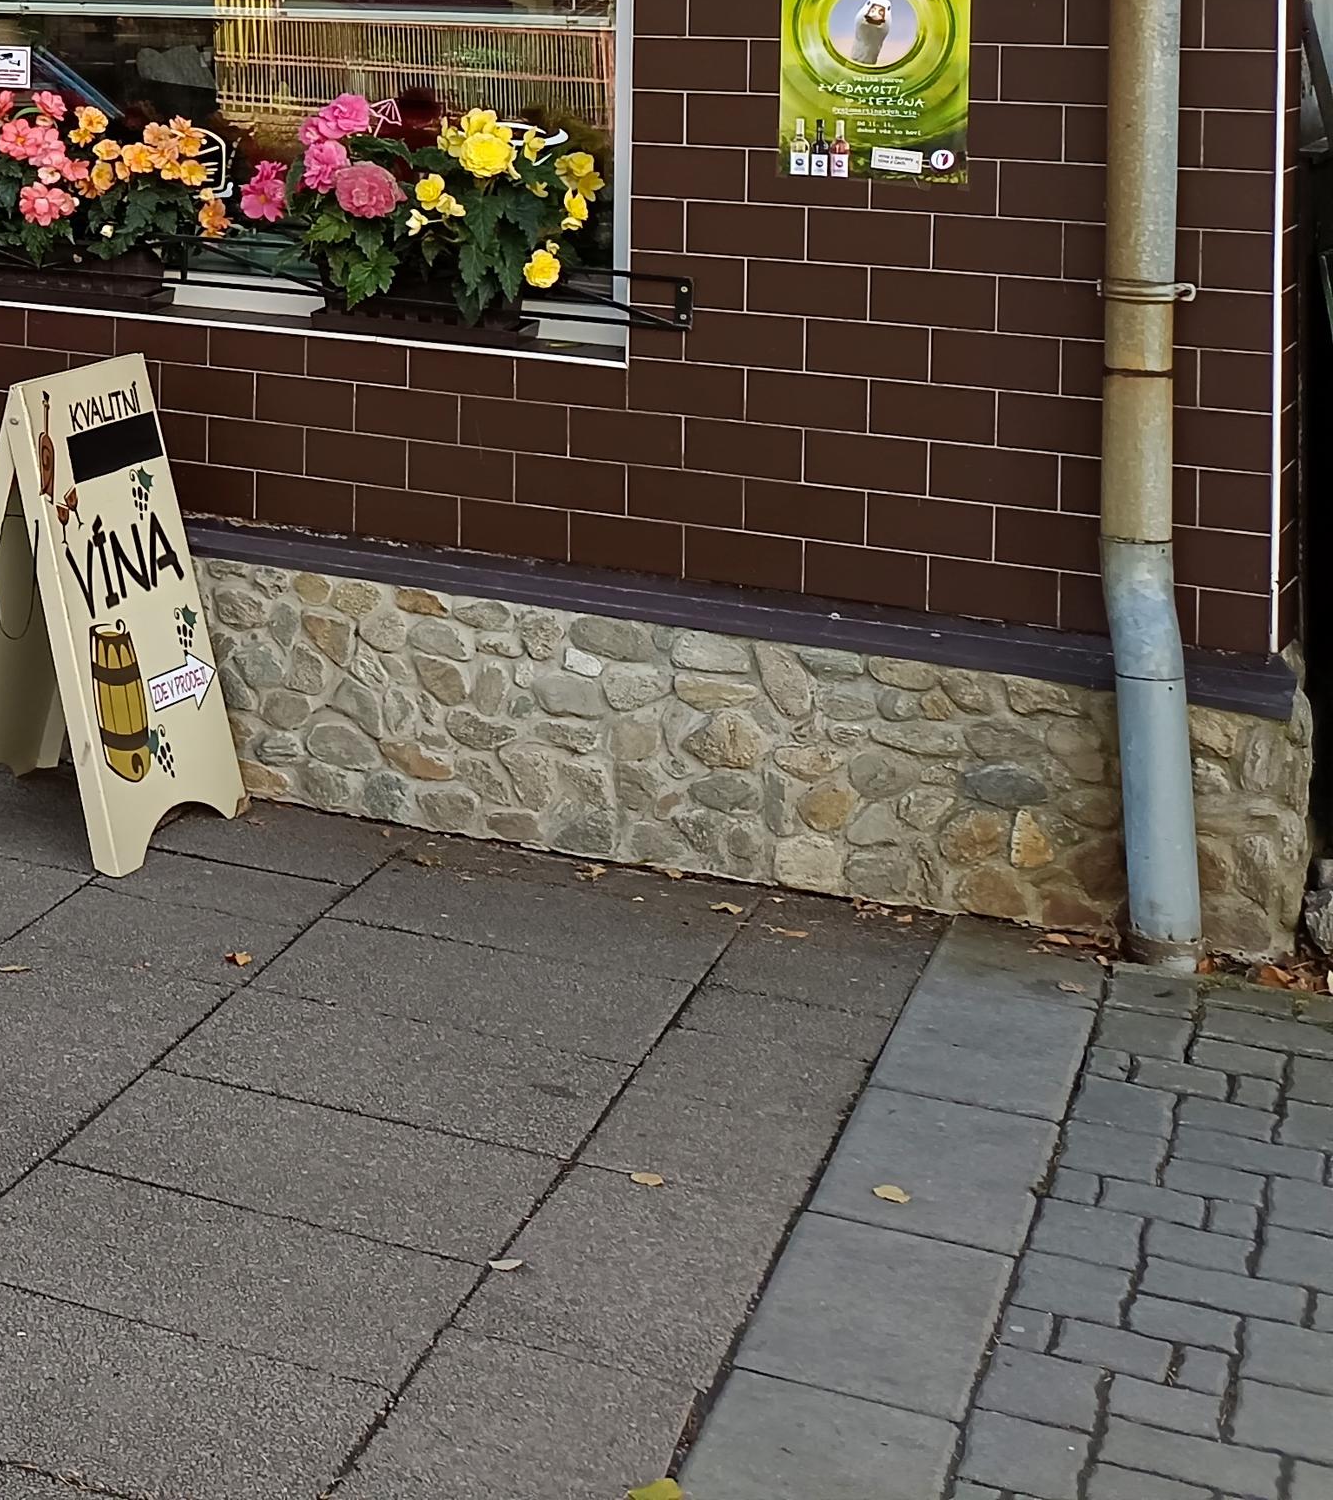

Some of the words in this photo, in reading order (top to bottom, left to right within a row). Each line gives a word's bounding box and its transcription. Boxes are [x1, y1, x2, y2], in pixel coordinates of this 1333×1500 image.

[68, 379, 143, 433] KVALITNÍ
[65, 513, 186, 620] VÍNA
[152, 682, 170, 705] ZDE
[167, 679, 175, 699] V
